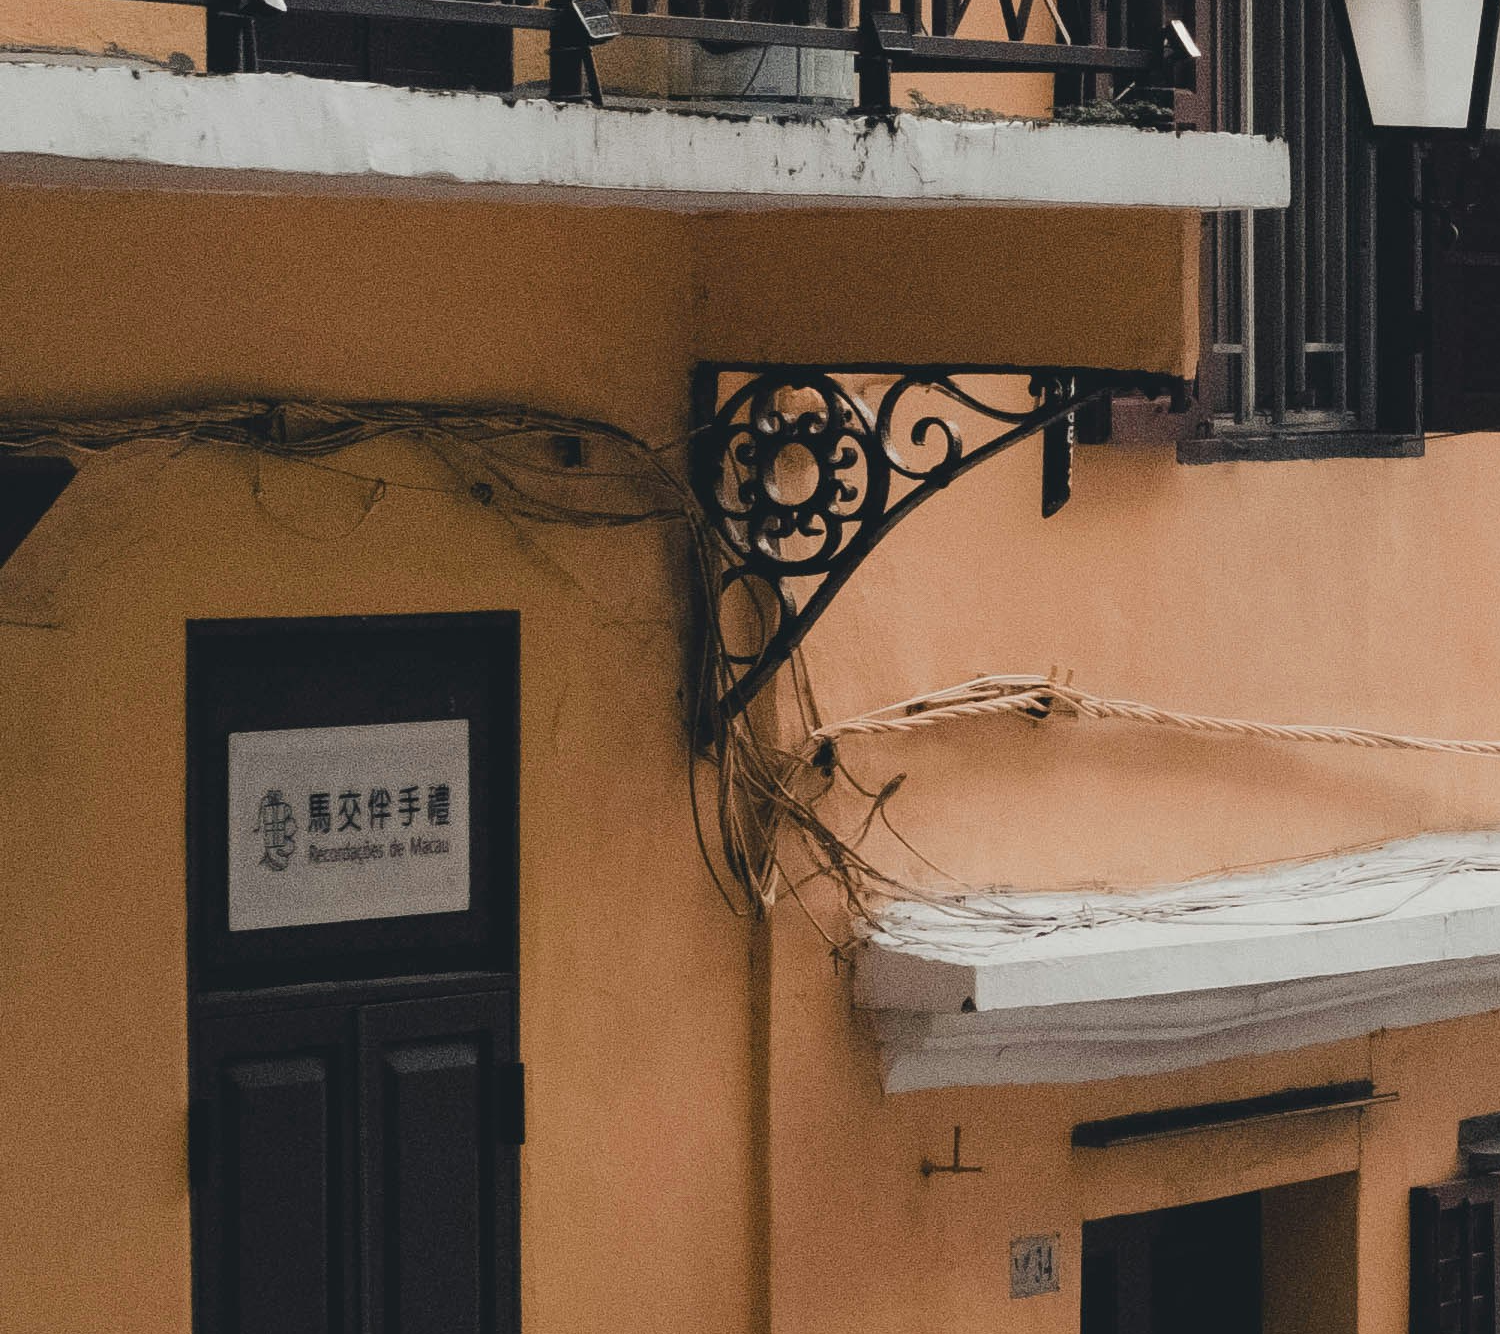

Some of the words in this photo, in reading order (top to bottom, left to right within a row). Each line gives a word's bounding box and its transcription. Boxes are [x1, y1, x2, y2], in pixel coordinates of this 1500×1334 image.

[307, 783, 451, 834] 馬交伴手禮
[390, 838, 405, 858] de
[410, 835, 450, 856] Macau
